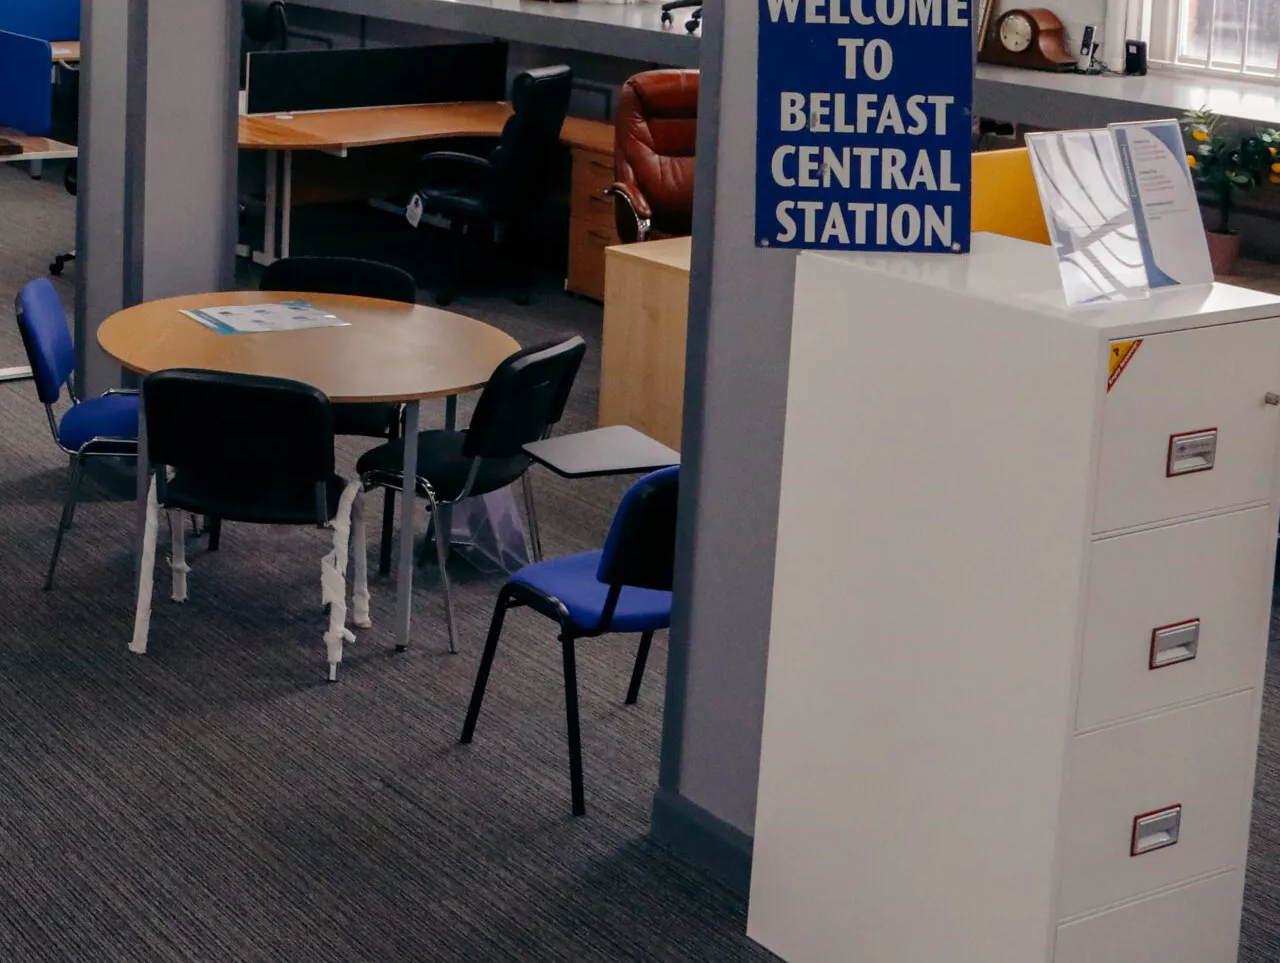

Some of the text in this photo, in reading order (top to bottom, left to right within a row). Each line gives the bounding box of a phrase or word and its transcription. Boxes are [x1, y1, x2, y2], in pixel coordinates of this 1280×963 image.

[837, 38, 893, 81] TO
[780, 91, 954, 136] BELFAST
[771, 144, 961, 192] CENTRAL
[775, 200, 953, 247] STATION
